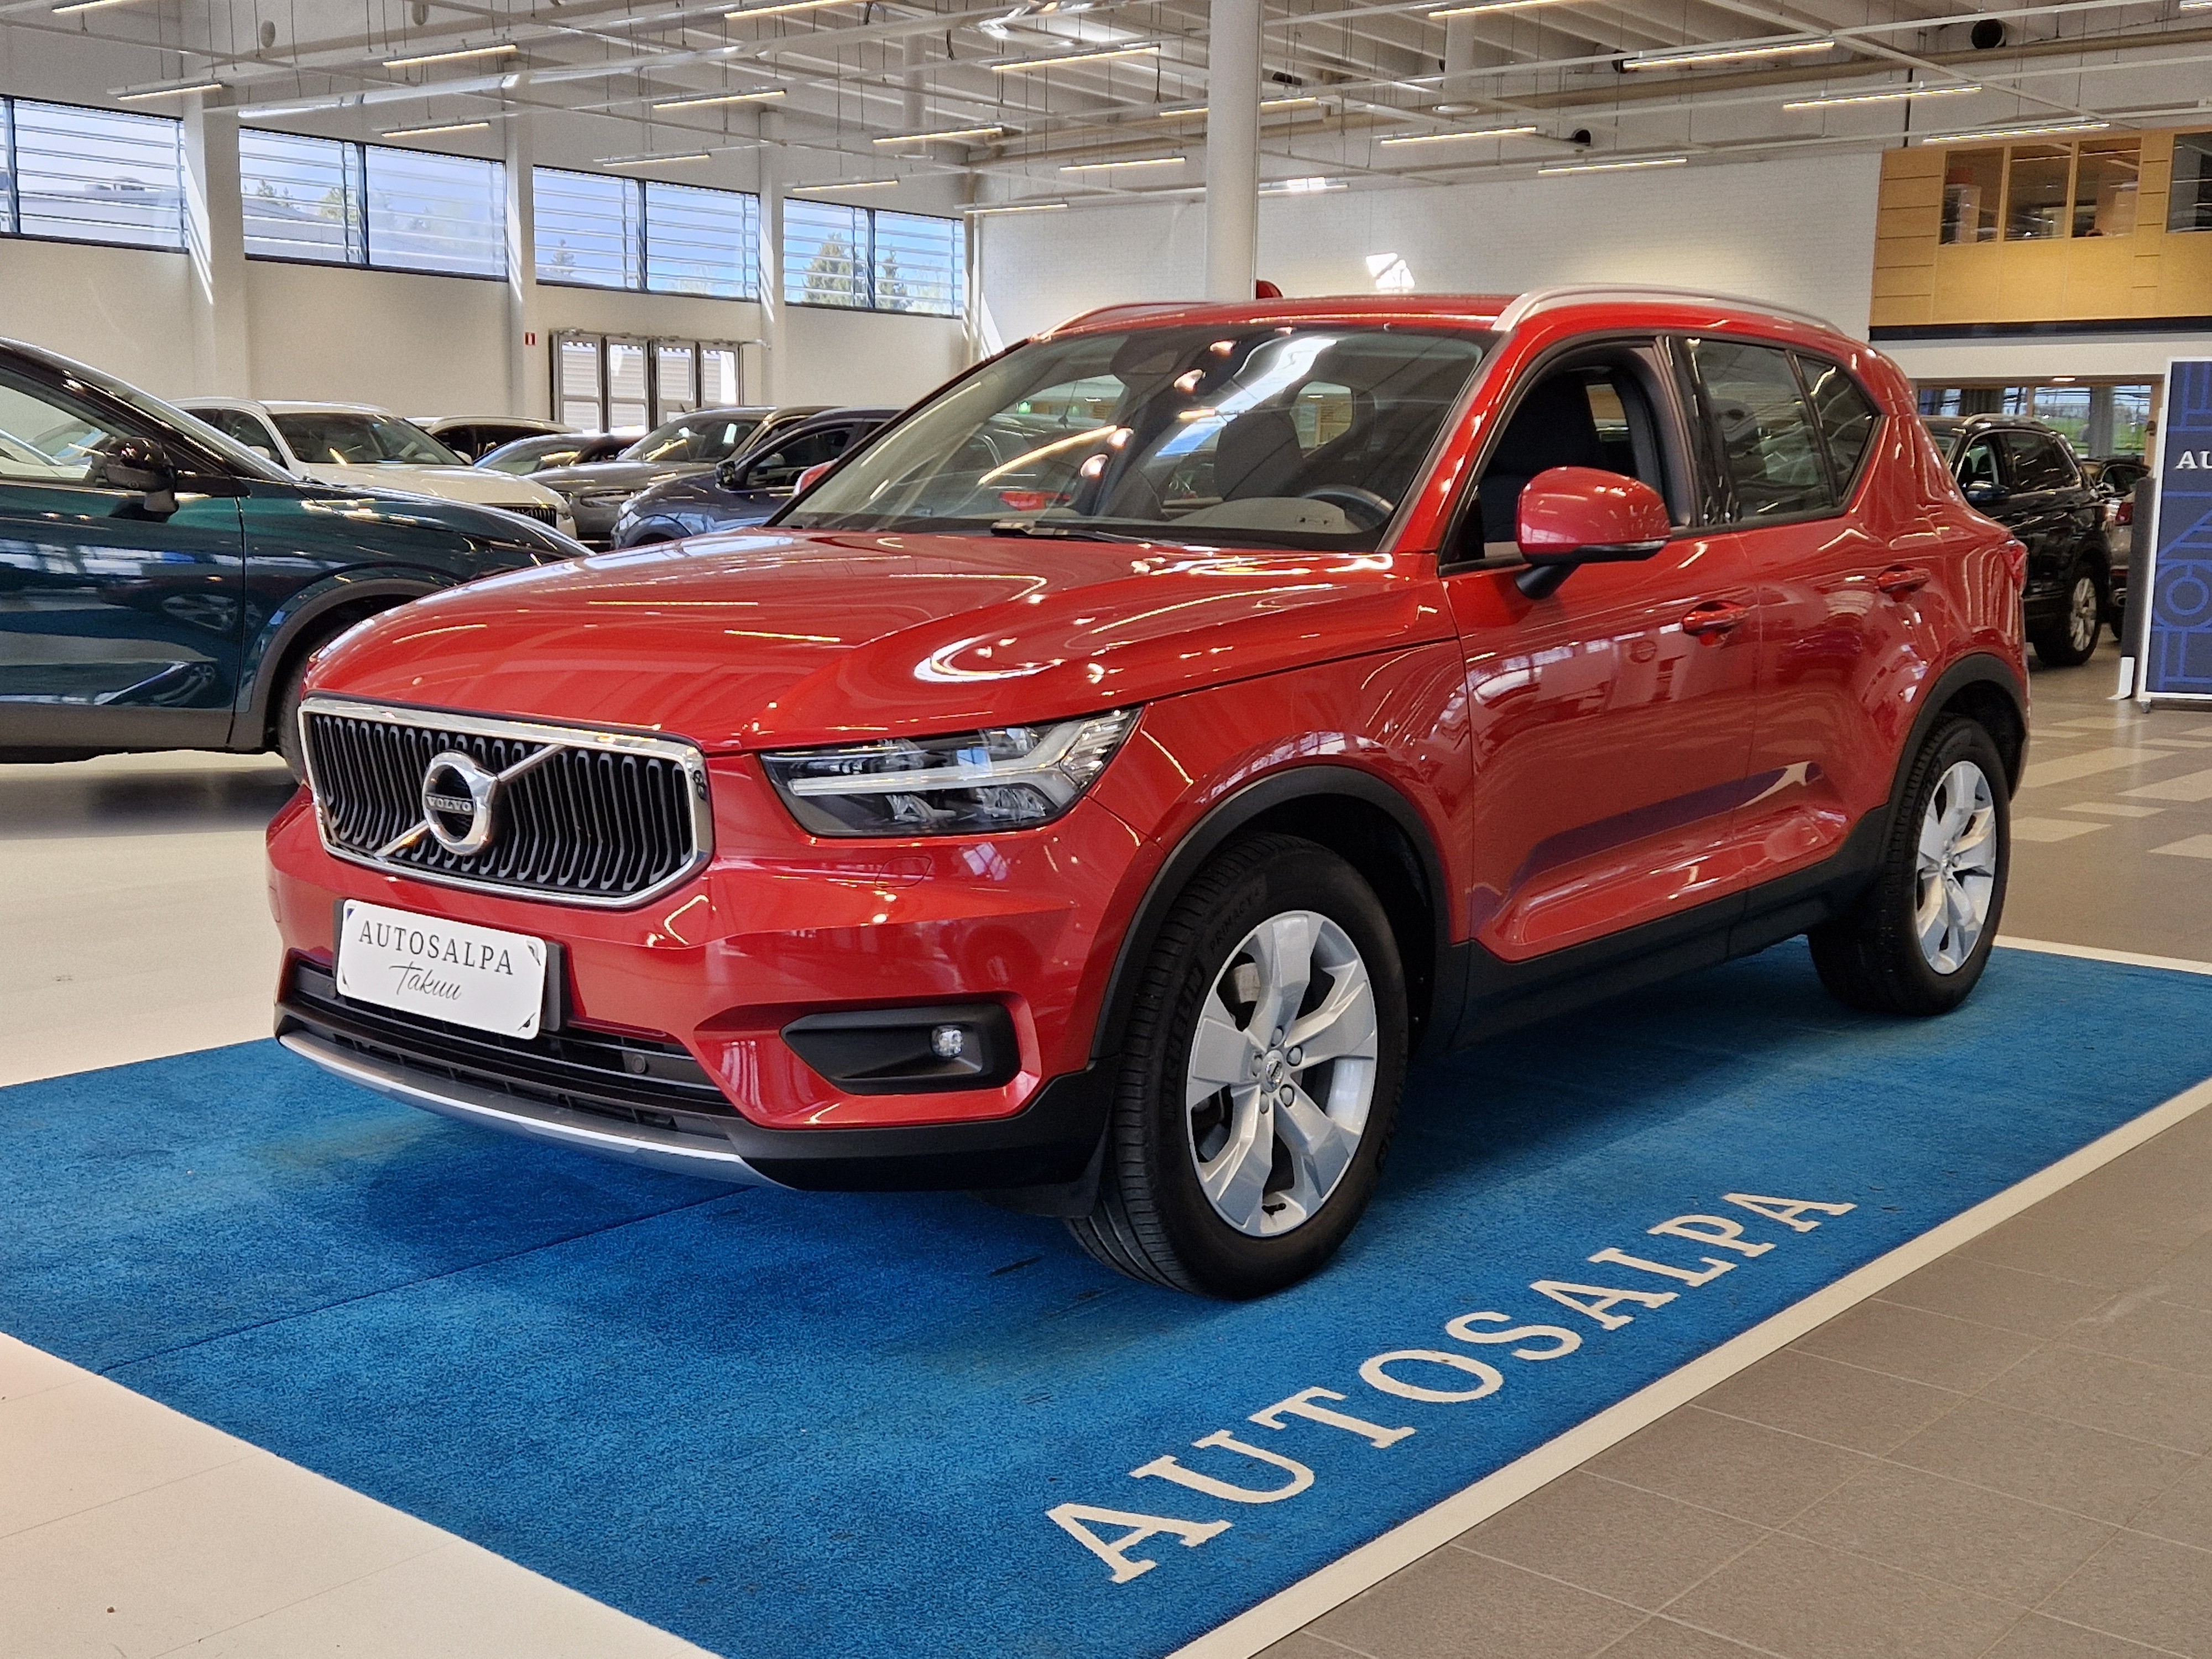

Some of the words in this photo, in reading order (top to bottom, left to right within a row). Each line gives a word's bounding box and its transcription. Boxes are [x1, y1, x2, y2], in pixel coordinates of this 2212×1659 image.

[426, 796, 472, 812] VOLVO
[358, 920, 513, 975] AUTOSALPA
[389, 961, 462, 1000] Takuu
[1161, 966, 1203, 1121] MICHELIN
[1045, 1192, 1858, 1584] AUTOSALPA
